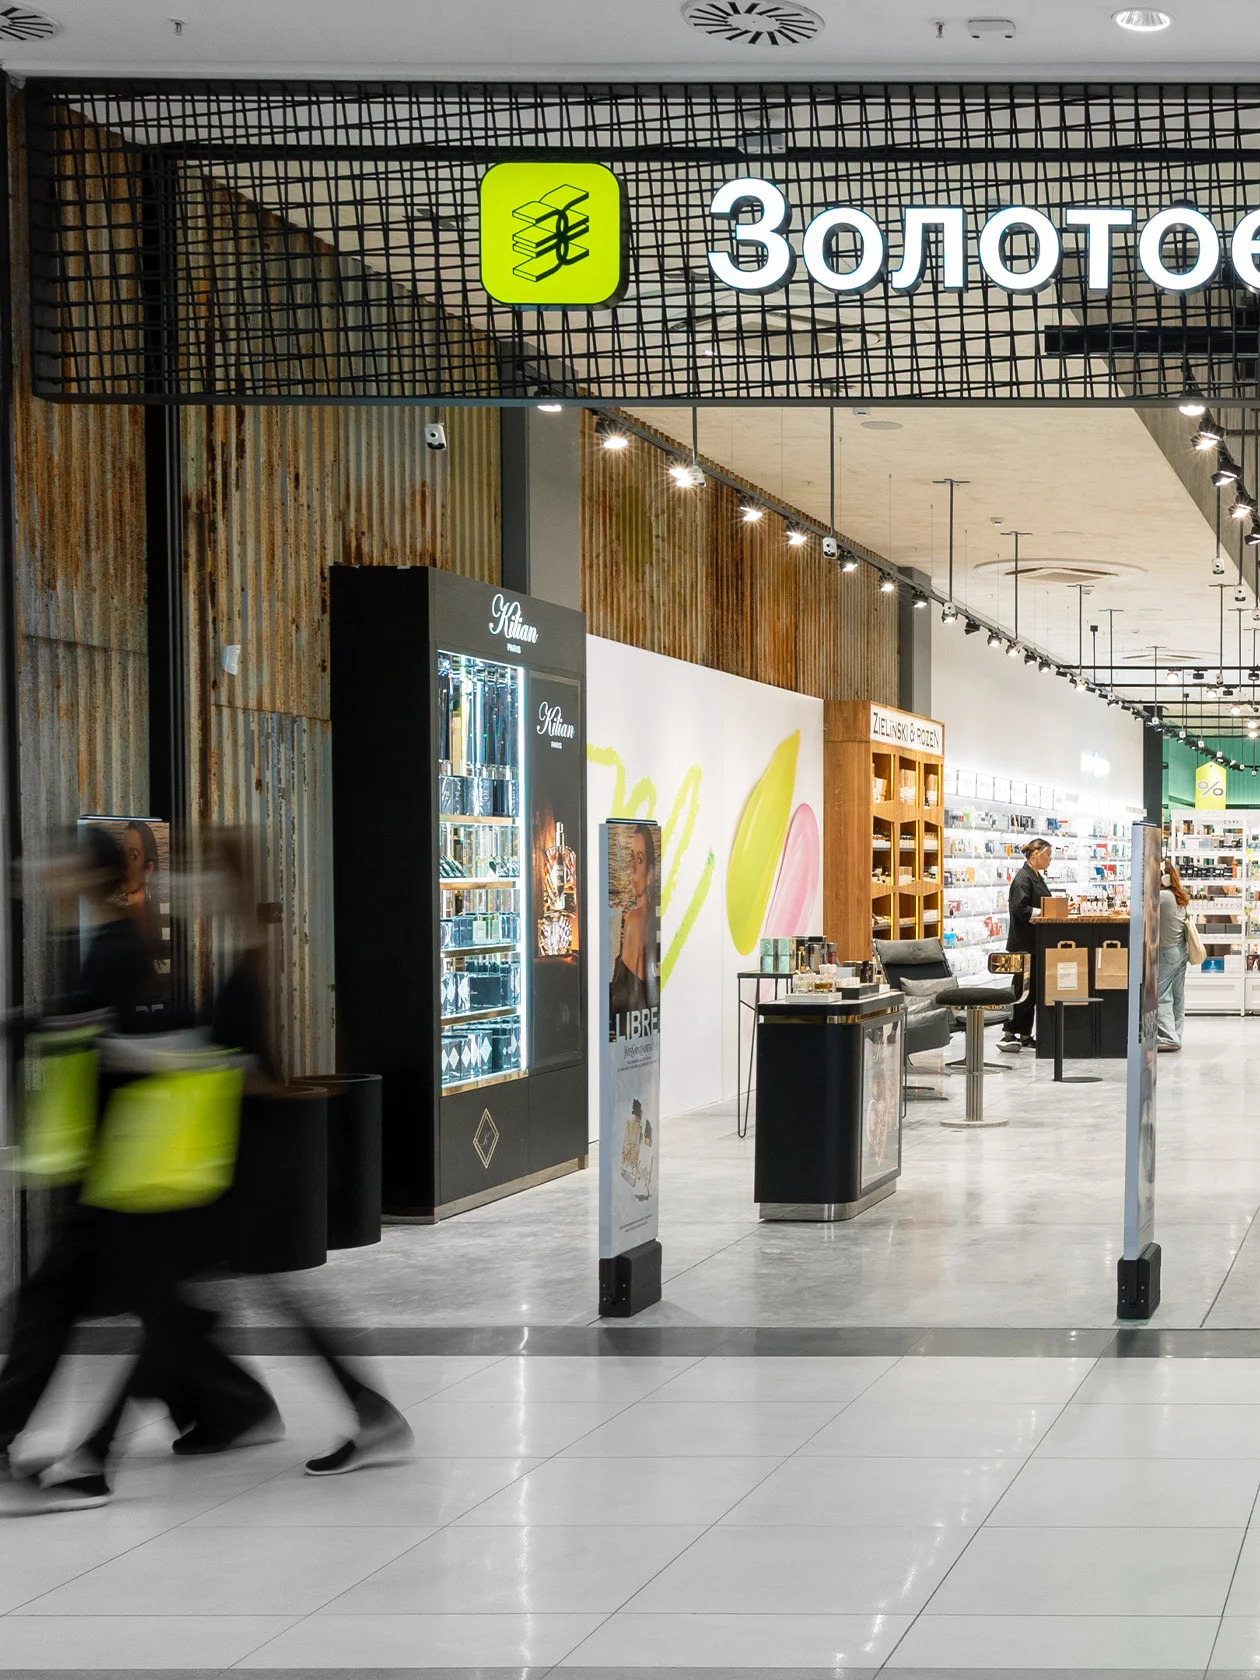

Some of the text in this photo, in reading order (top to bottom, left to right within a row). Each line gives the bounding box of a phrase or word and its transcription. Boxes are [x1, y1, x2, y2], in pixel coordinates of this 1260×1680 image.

[489, 593, 539, 644] Kilian
[536, 701, 575, 739] Kilian
[916, 727, 940, 749] ROZEN
[616, 1006, 659, 1042] LIBRE
